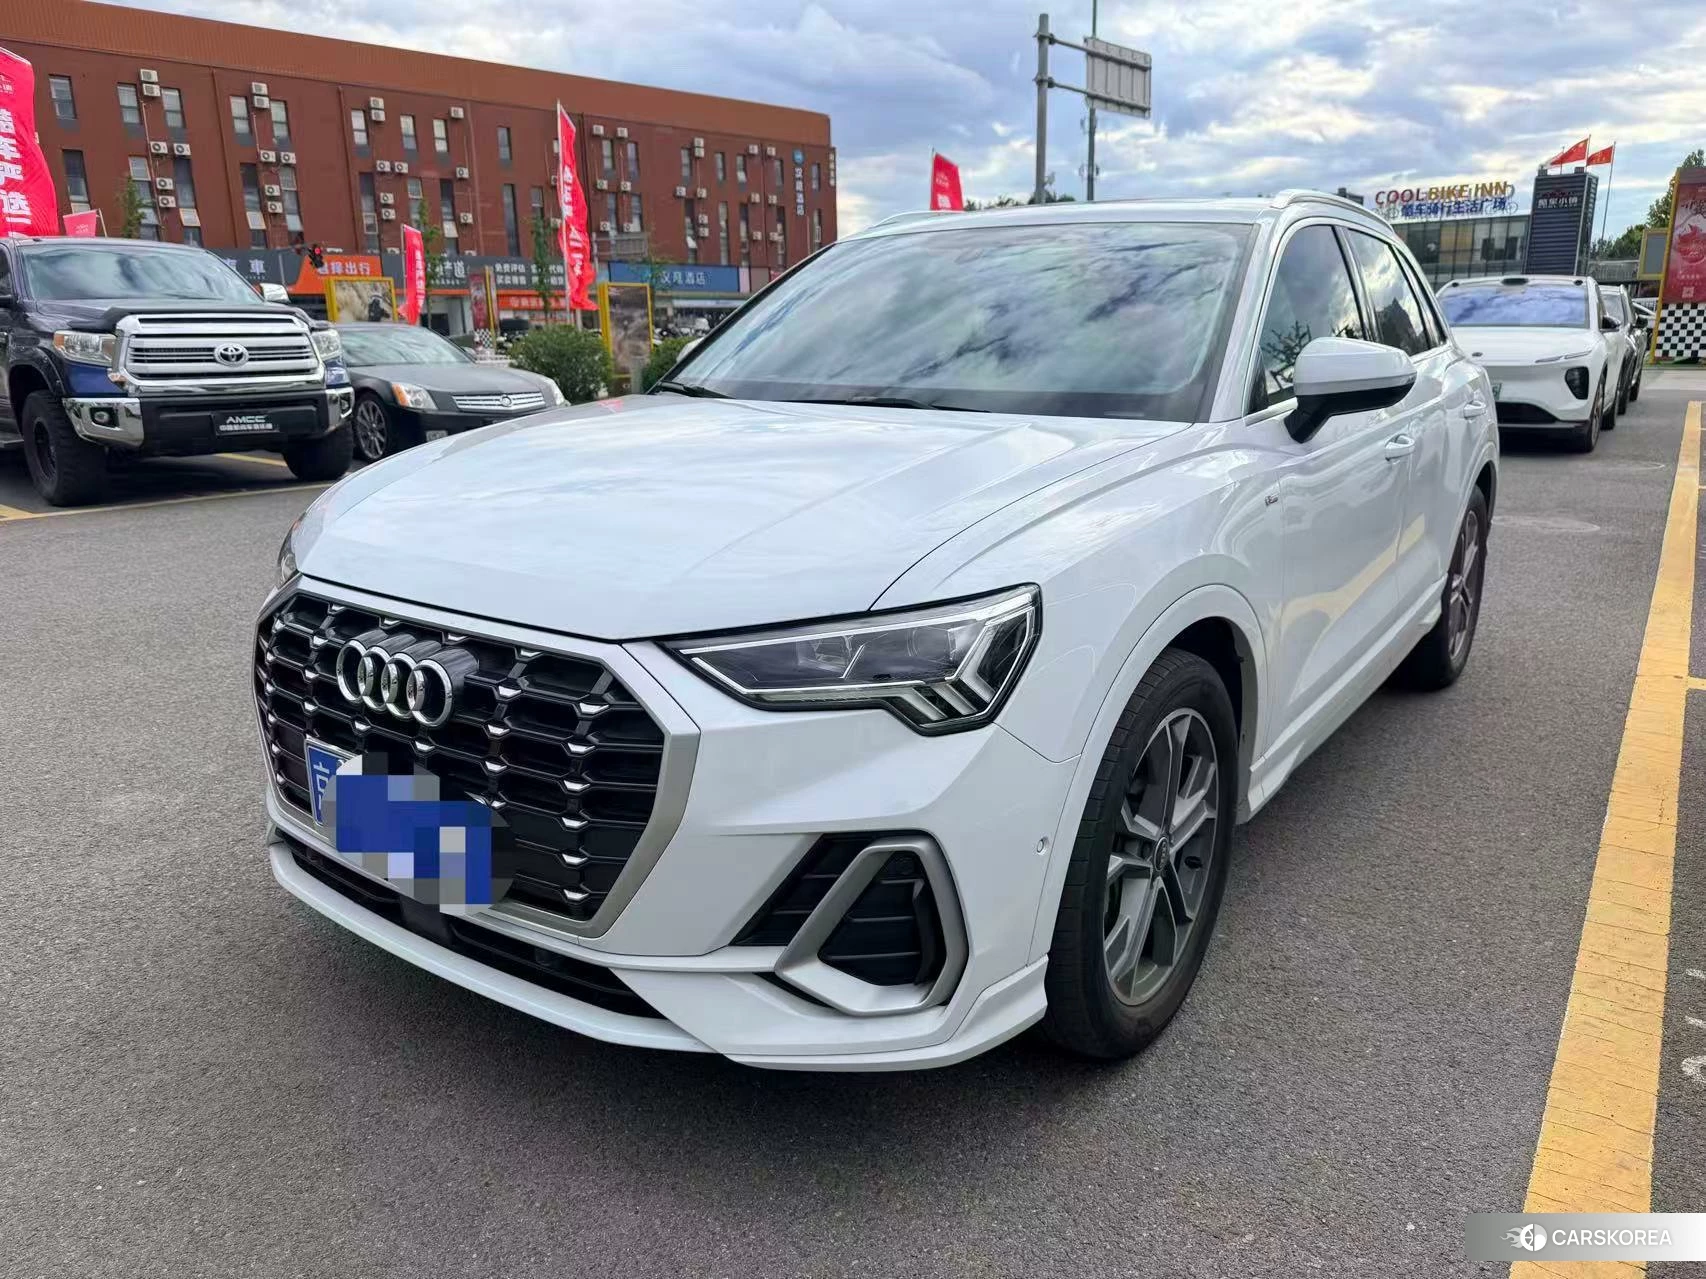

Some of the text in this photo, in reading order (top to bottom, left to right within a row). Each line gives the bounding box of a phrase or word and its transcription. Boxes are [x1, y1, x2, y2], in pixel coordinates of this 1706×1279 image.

[1375, 181, 1508, 205] COOL BIKE INN
